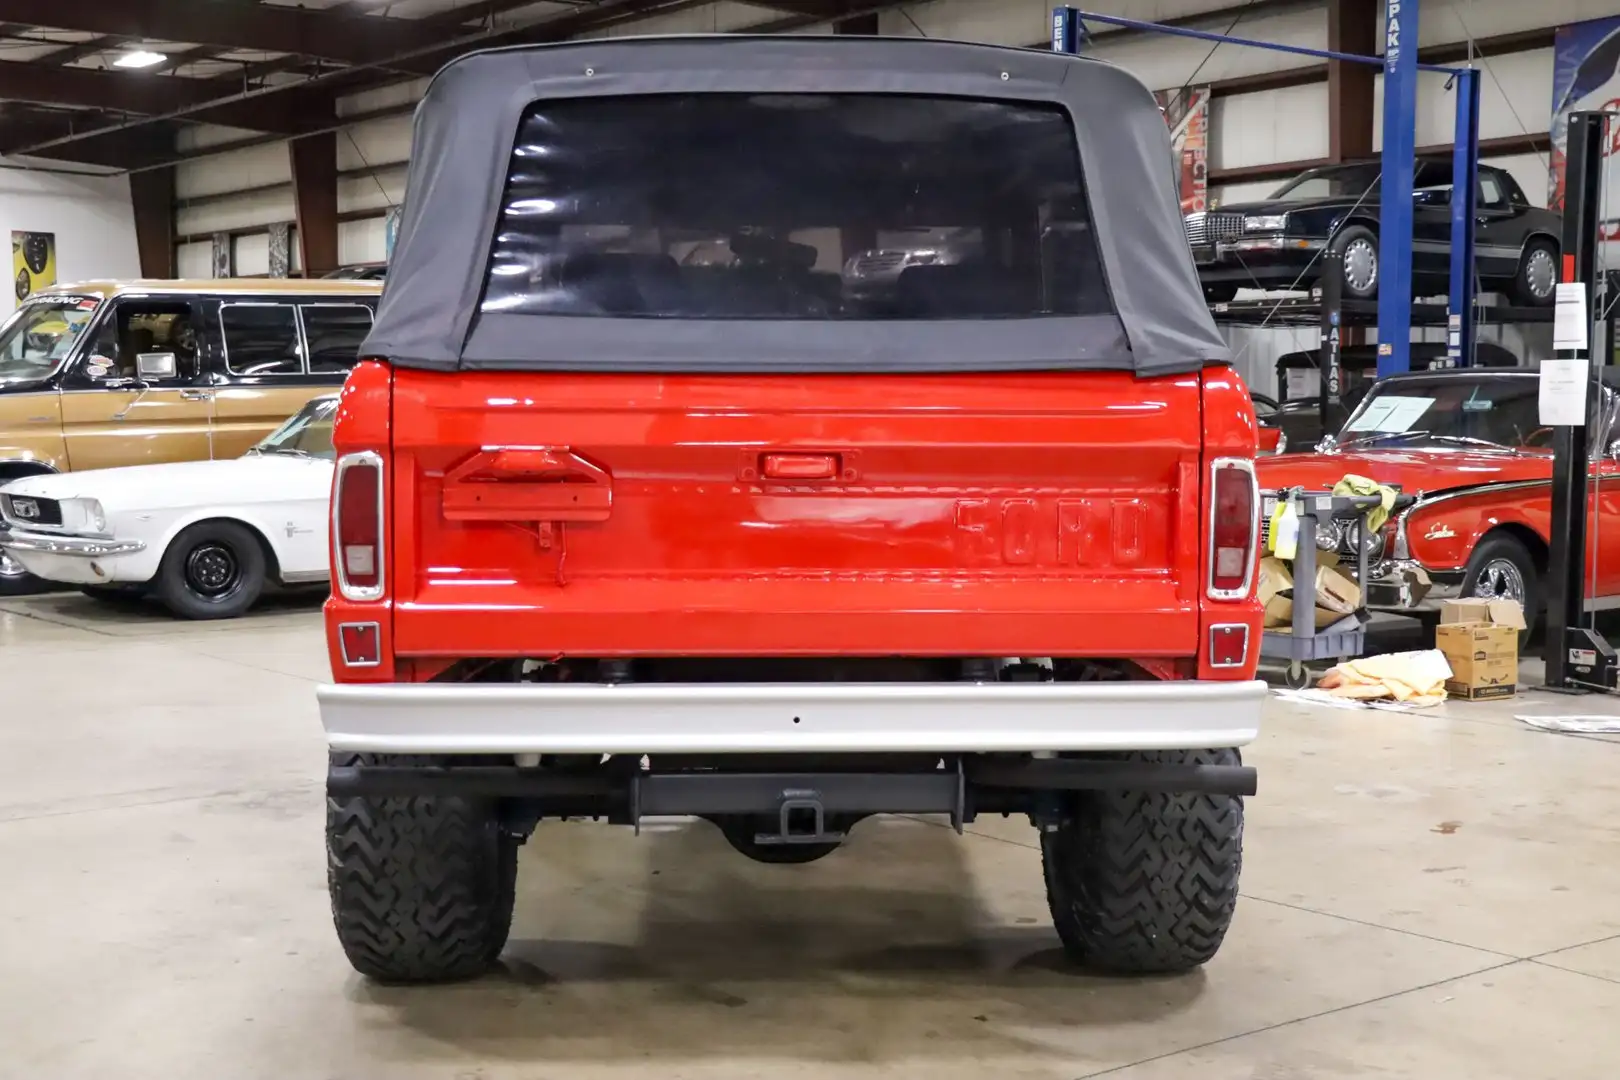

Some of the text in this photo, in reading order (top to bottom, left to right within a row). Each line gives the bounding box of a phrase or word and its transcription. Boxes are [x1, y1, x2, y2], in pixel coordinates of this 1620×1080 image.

[1388, 0, 1400, 47] PAK
[1329, 327, 1340, 393] ATLAS
[953, 497, 1149, 566] FORD
